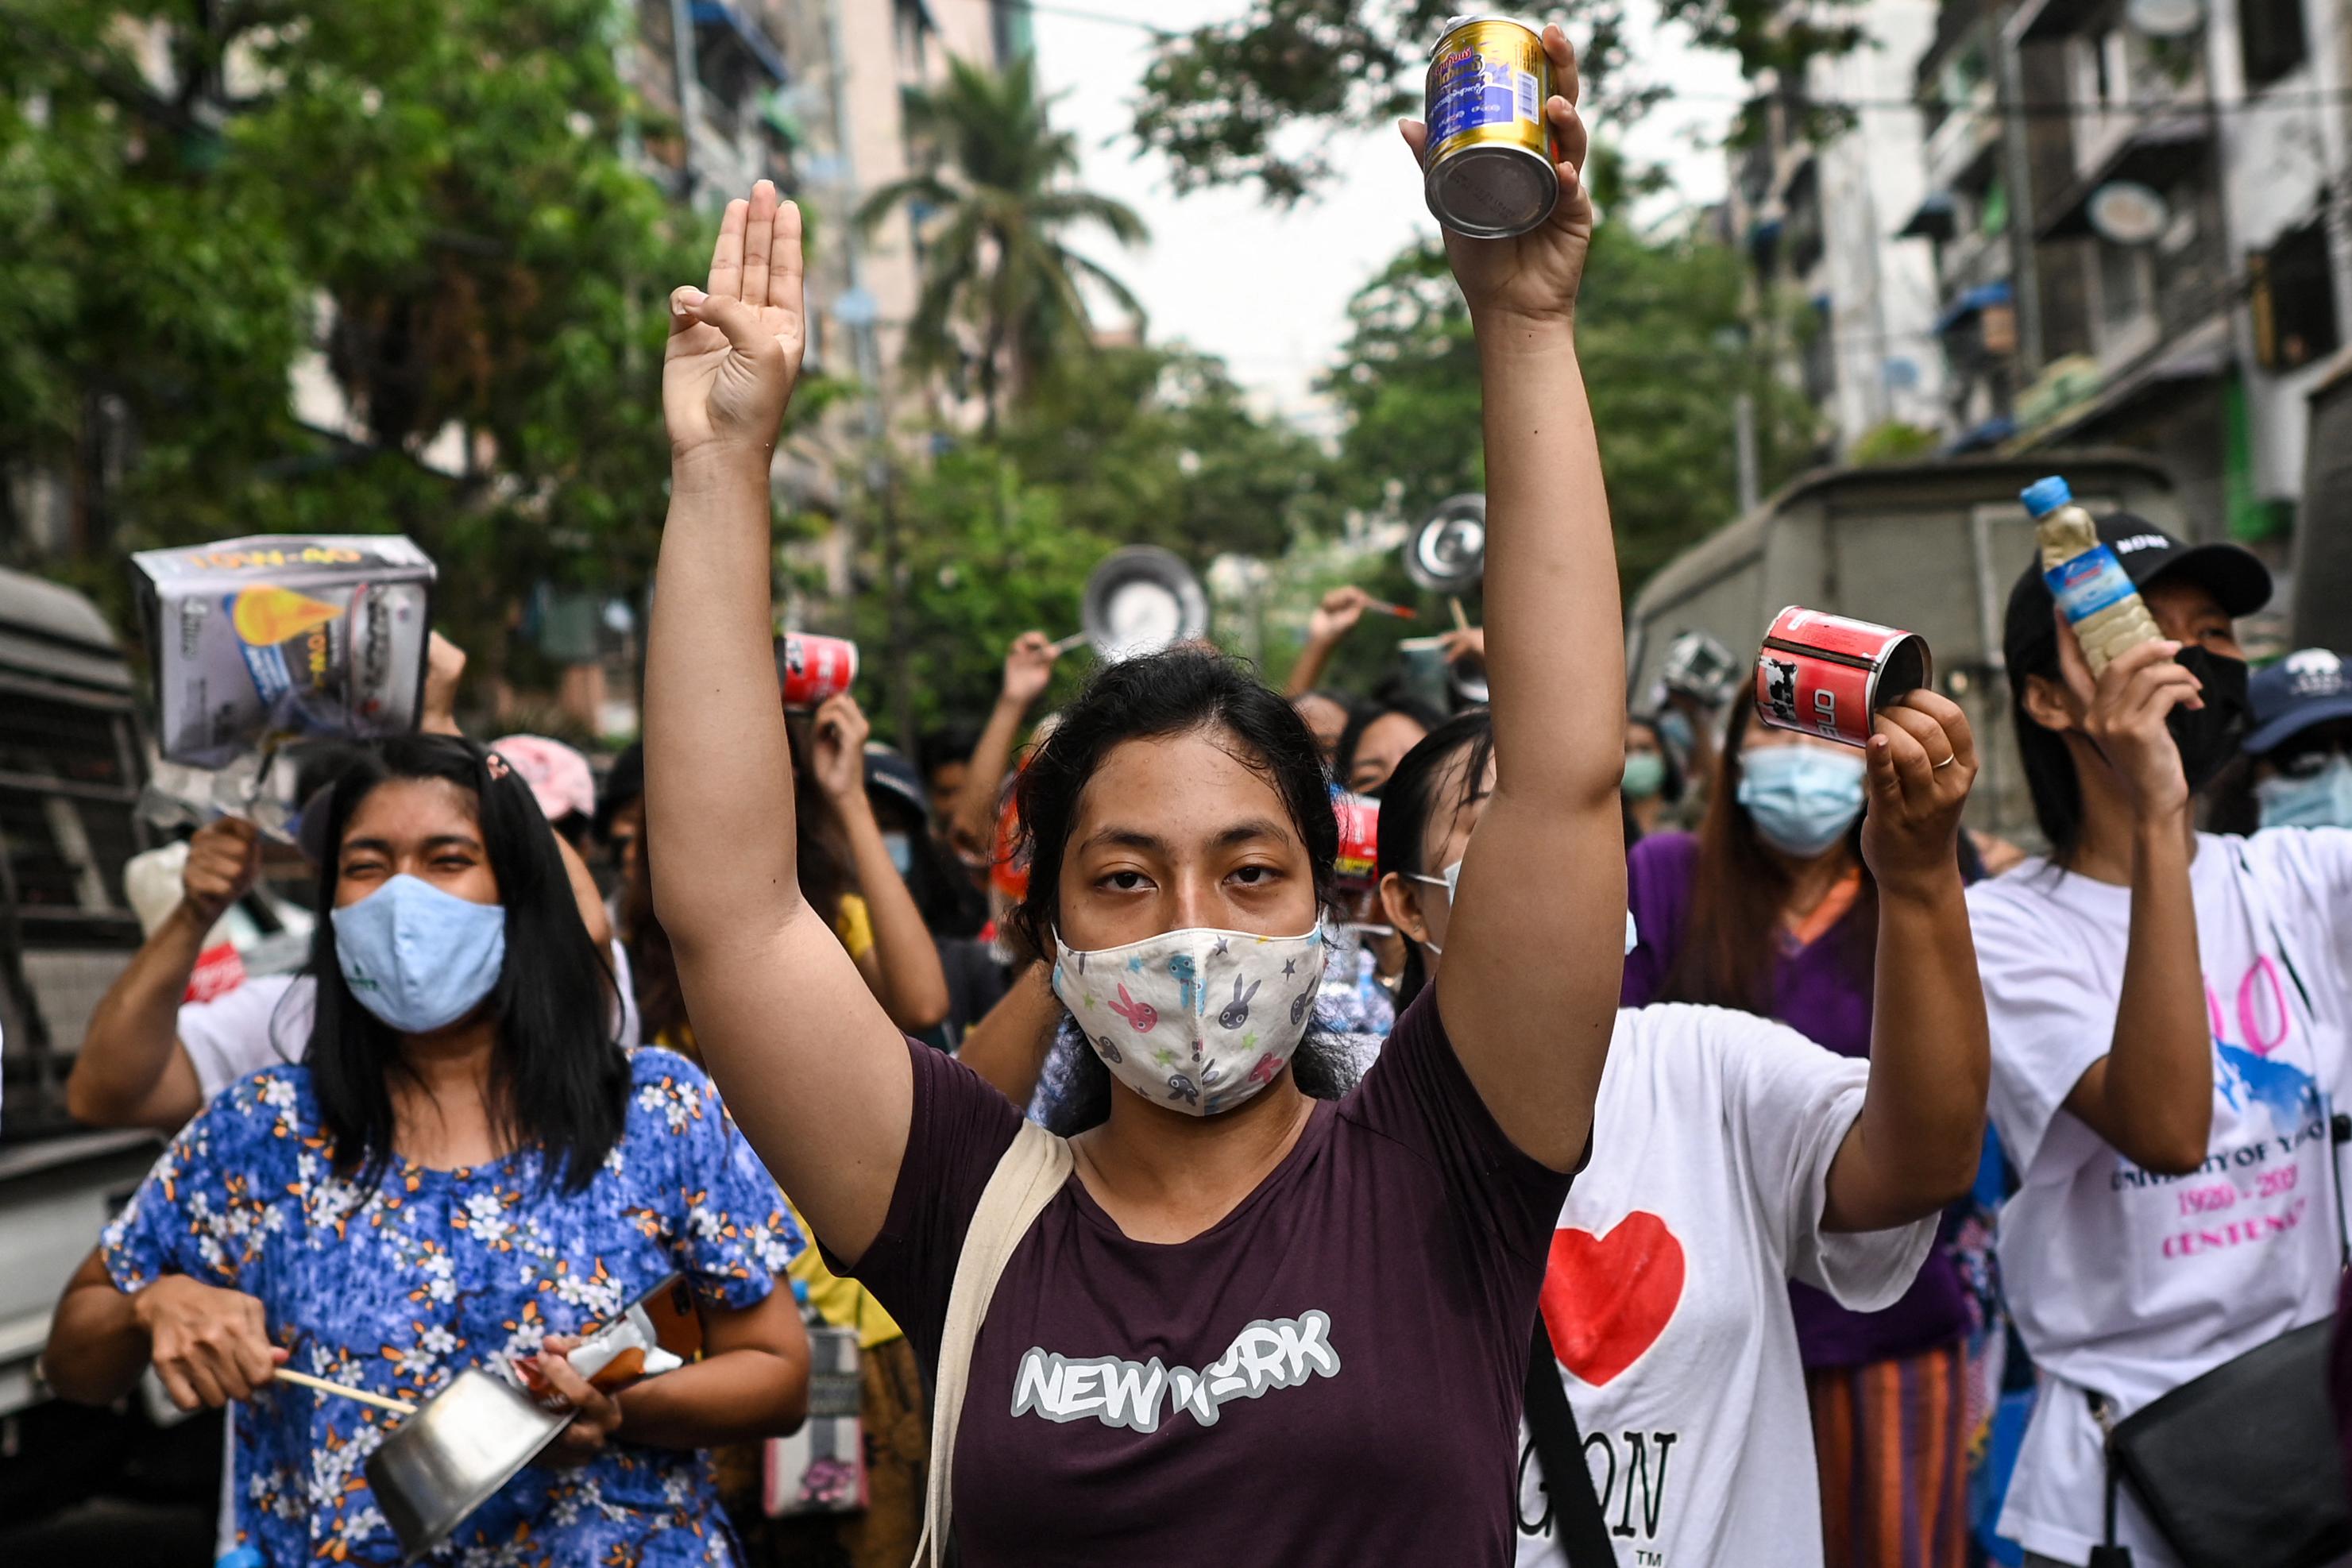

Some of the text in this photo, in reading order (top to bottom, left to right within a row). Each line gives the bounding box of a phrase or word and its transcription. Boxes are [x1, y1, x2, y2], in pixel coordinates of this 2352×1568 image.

[2234, 1143, 2266, 1168] OF
[1012, 1349, 1168, 1431] NEW
[1636, 1550, 1663, 1567] TM
